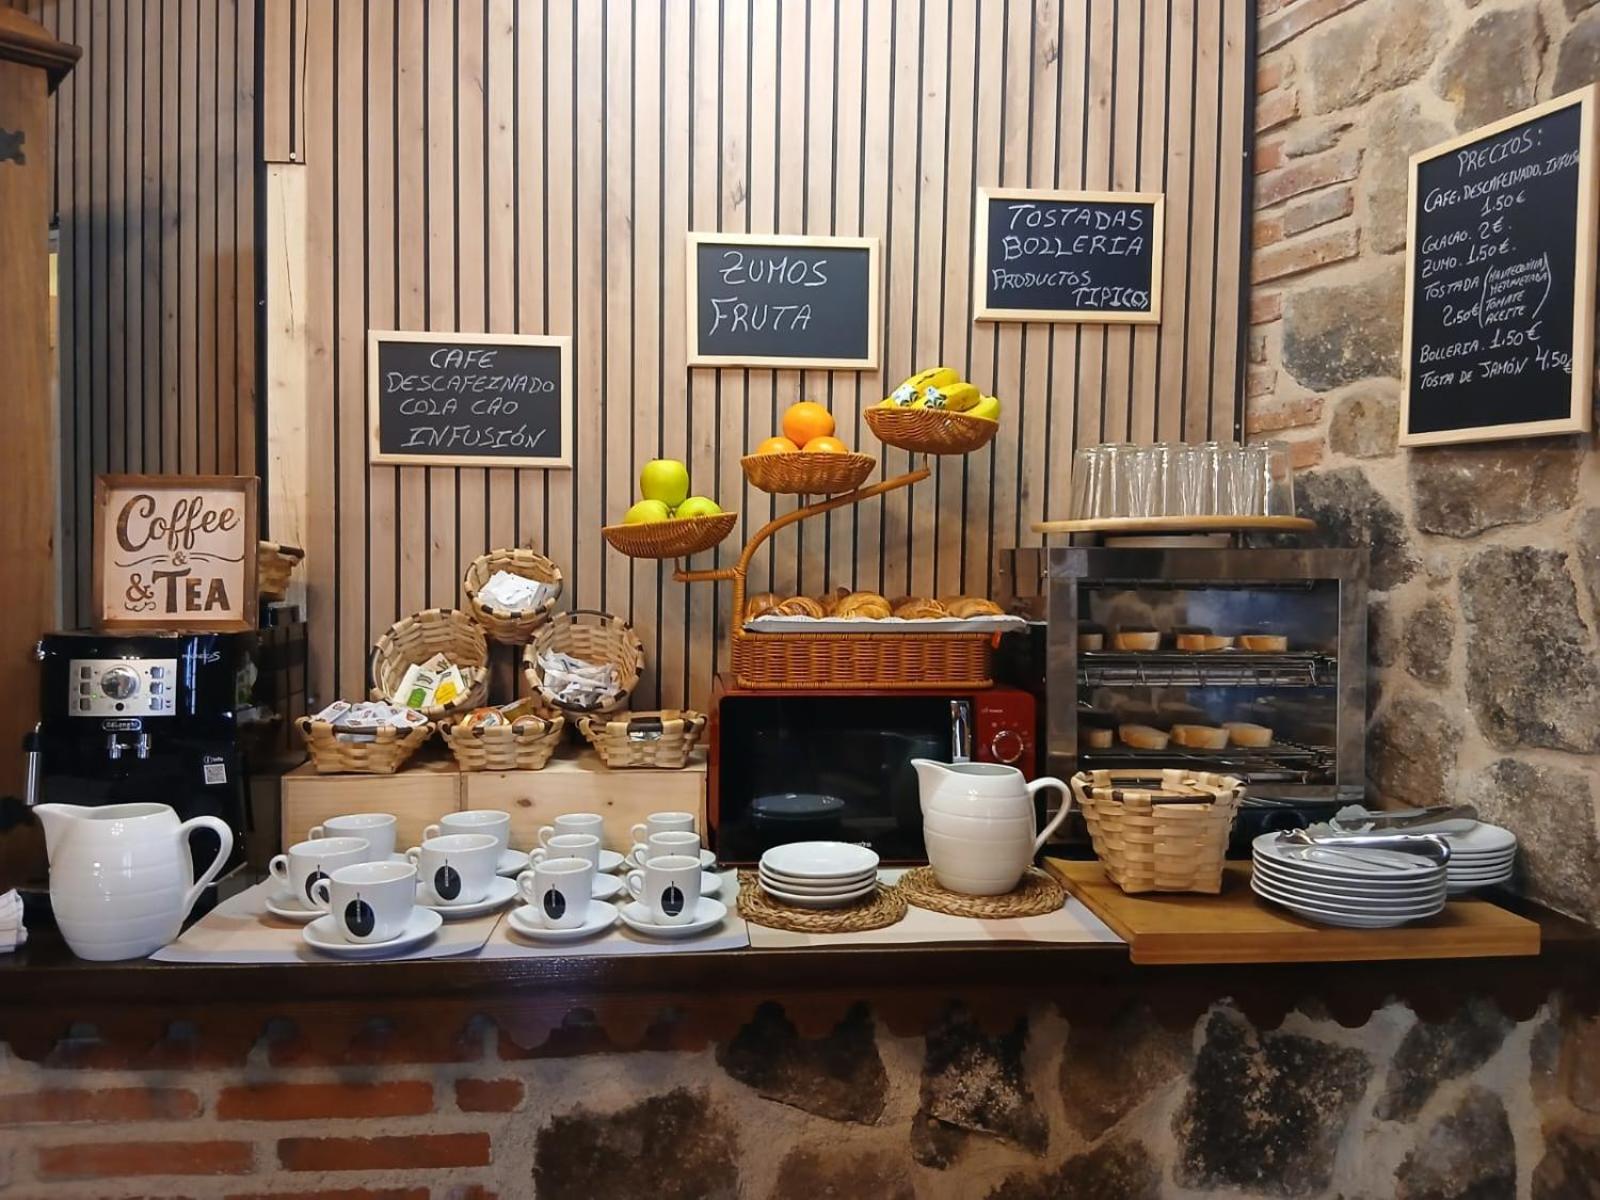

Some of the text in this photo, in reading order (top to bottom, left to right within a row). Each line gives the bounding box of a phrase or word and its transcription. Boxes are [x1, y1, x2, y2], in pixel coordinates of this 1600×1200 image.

[1008, 203, 1144, 231] TOSTADAS
[1001, 234, 1144, 262] BOLLERIA
[719, 250, 828, 287] ZUMOS
[991, 268, 1092, 291] PRODUCTOS
[1423, 275, 1480, 301] TOSTADA
[708, 296, 812, 336] FRUTA
[429, 348, 499, 369] CAFE
[1420, 370, 1455, 390] TOSTA
[1458, 370, 1474, 384] DE
[1477, 357, 1529, 379] JAMÓN
[399, 396, 519, 416] COLA CAO
[400, 424, 547, 449] INFUSIÓN
[116, 494, 240, 552] Coffee
[152, 567, 231, 613] TEA
